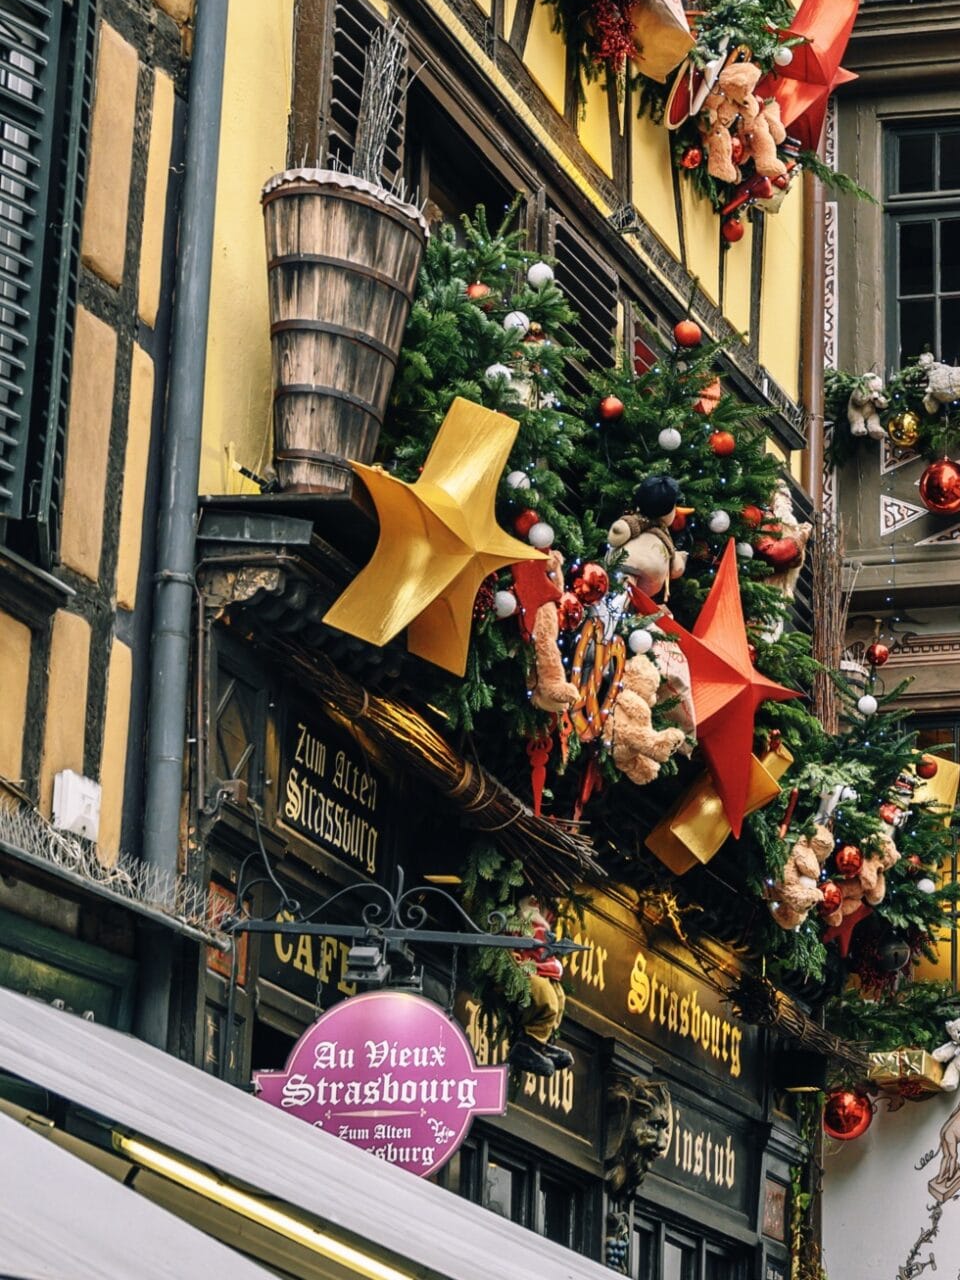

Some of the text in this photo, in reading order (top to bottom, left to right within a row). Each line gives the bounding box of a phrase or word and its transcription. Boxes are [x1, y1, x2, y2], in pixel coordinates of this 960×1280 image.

[294, 723, 377, 812] Zum Alten
[285, 768, 378, 874] Strassburg
[313, 1040, 447, 1070] Au Vieux
[627, 951, 742, 1079] Strasbourg
[281, 1073, 478, 1108] Strasbourg
[338, 1123, 412, 1140] Zum Alten
[661, 1099, 736, 1190] instub
